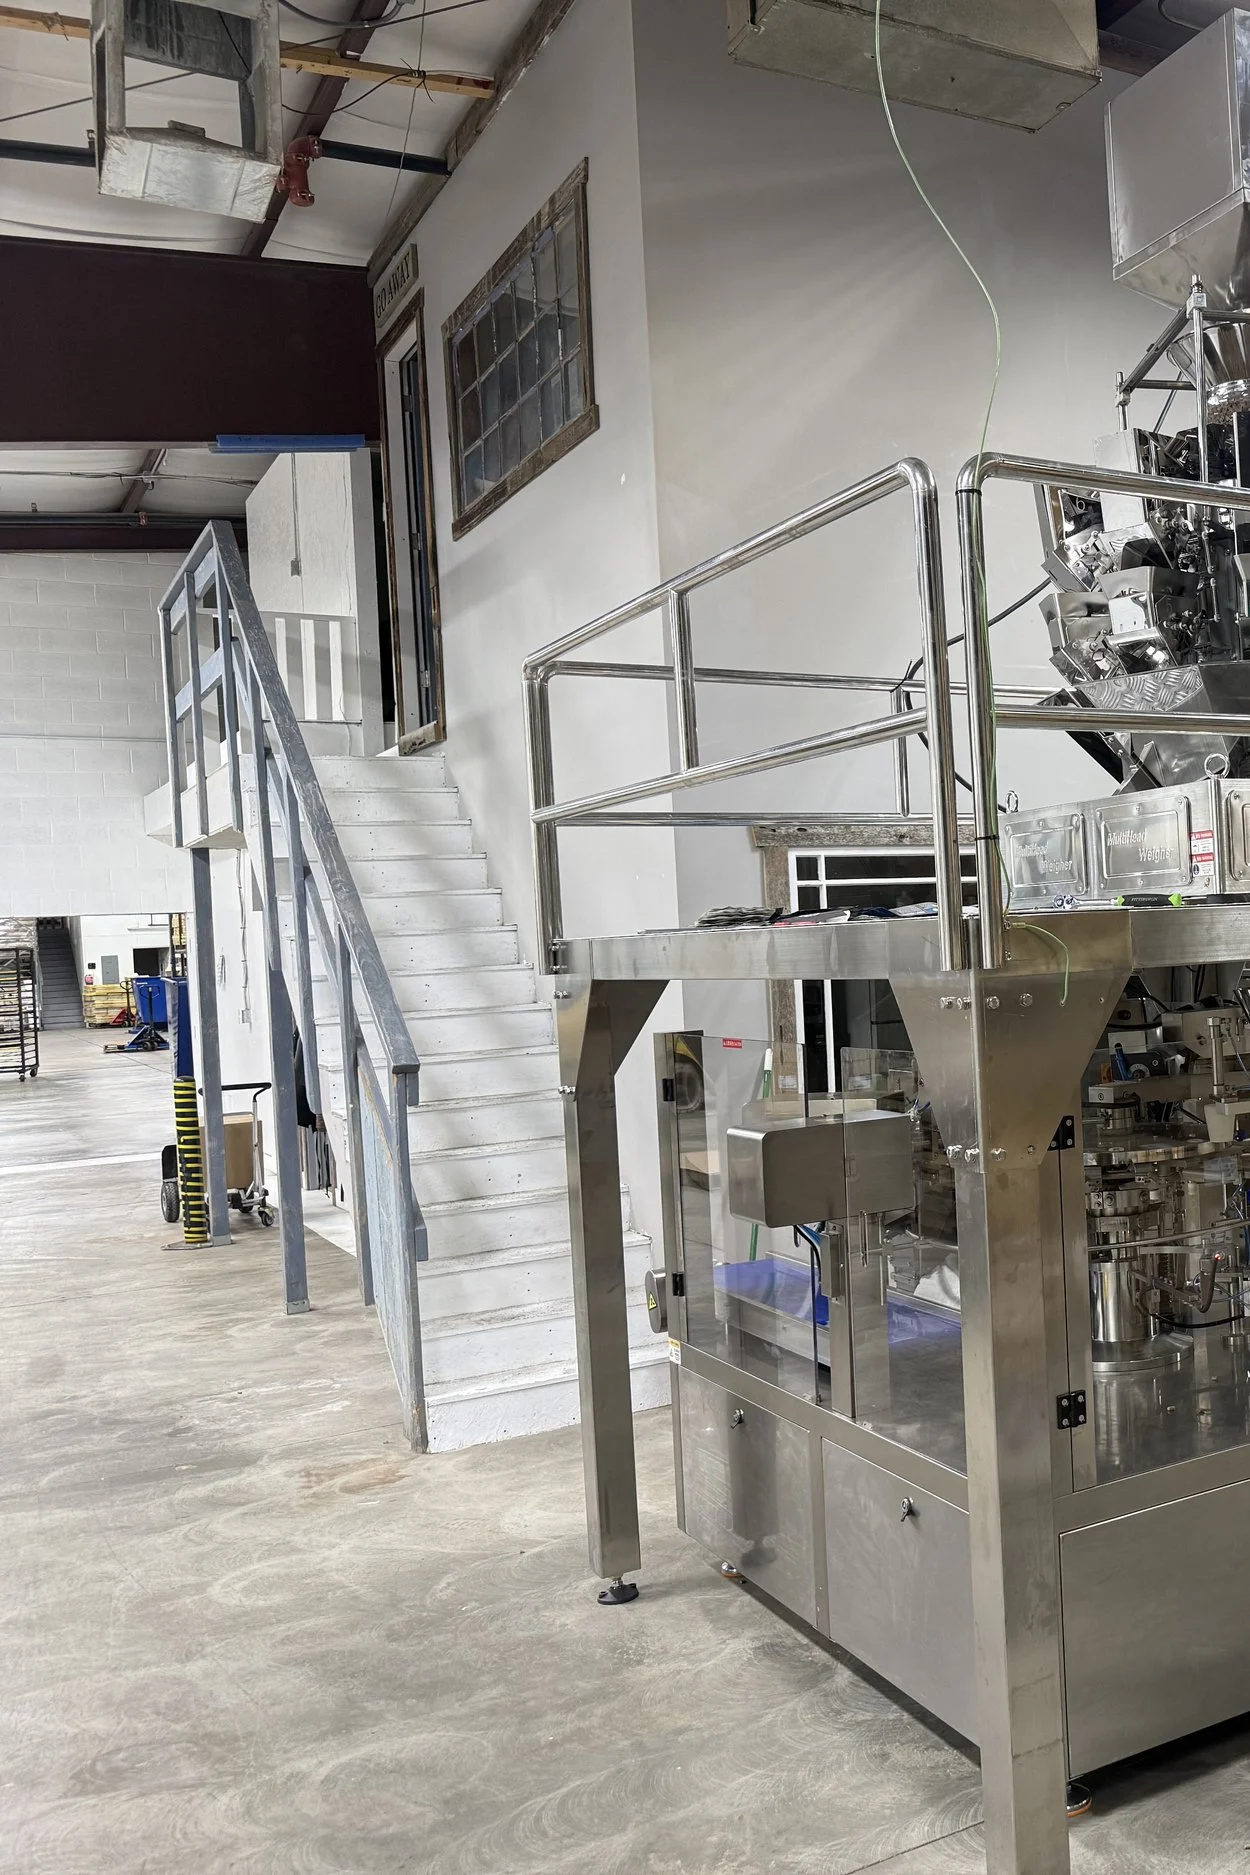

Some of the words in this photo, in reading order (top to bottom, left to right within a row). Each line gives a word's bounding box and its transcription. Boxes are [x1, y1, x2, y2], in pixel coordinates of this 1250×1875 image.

[376, 288, 386, 319] GO
[388, 251, 410, 305] AWAY
[1106, 827, 1149, 847] MultiHead
[1138, 847, 1175, 863] Weigher
